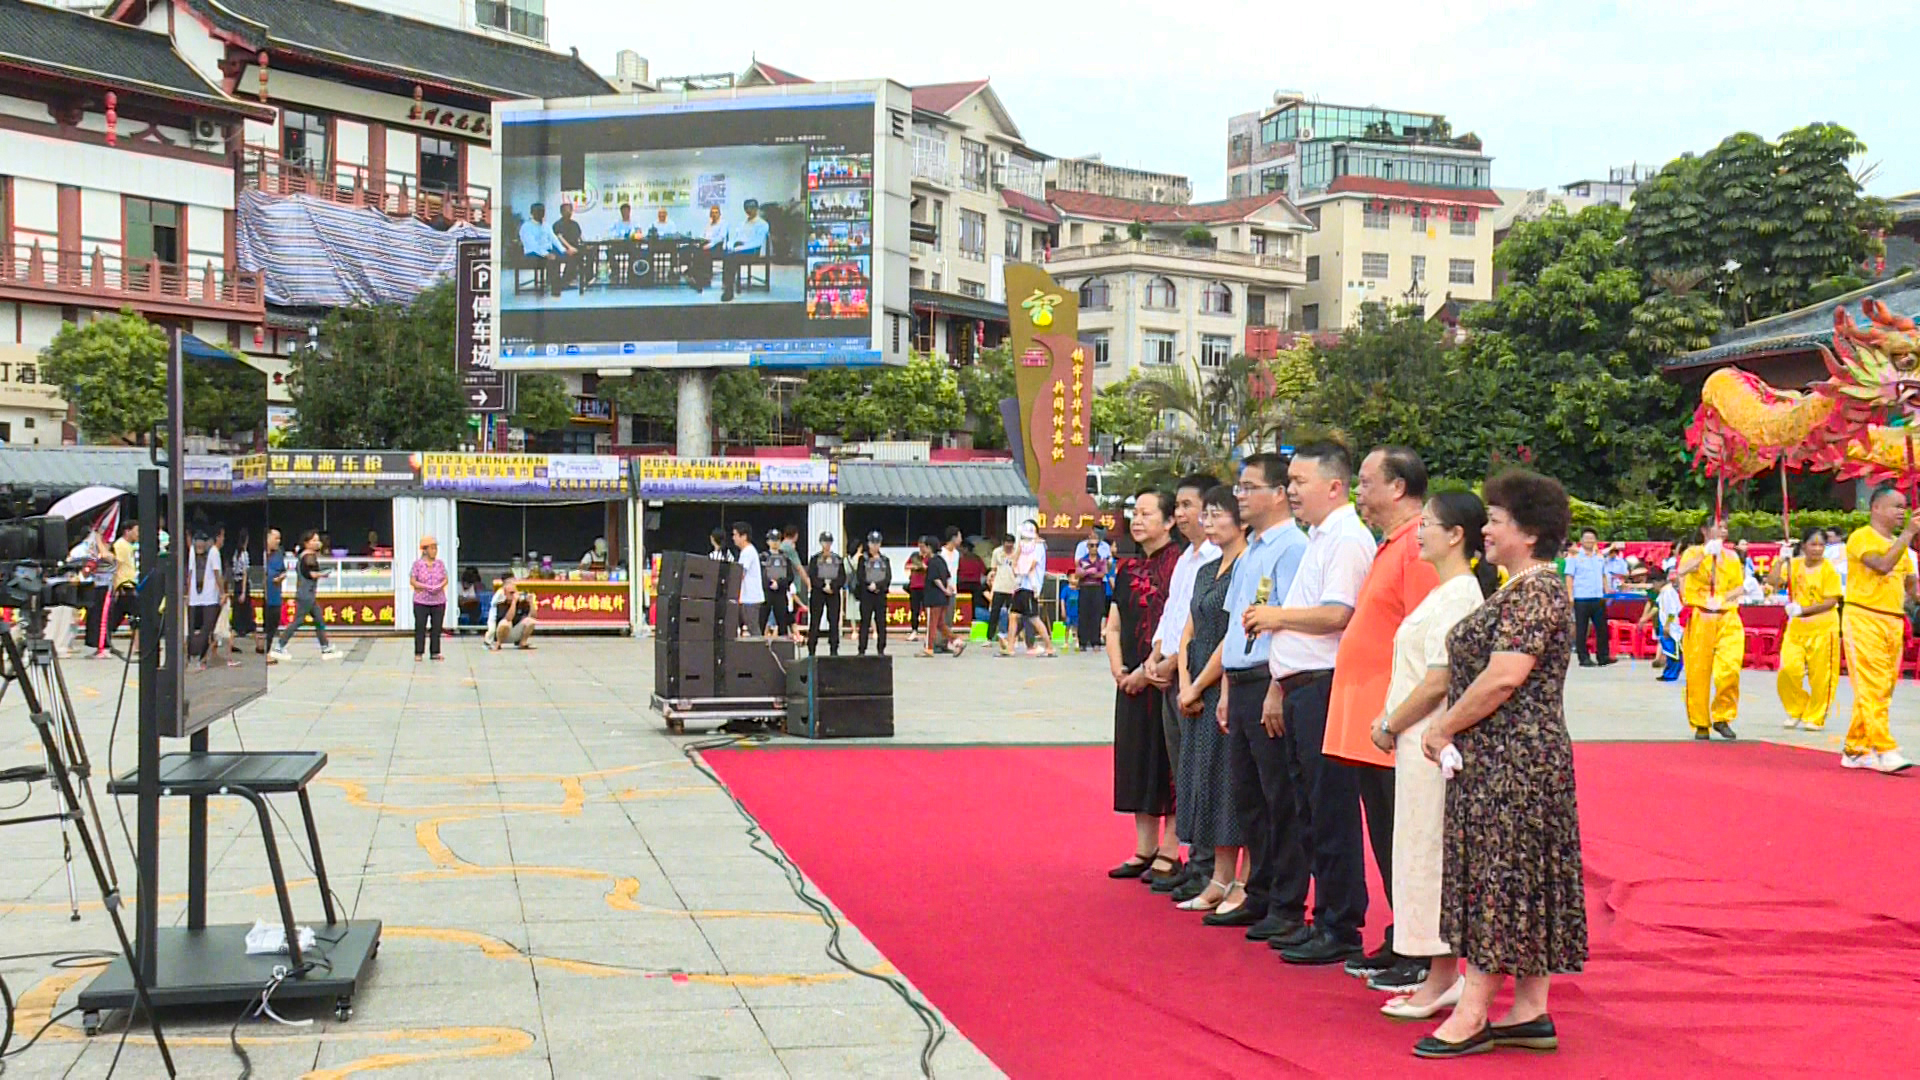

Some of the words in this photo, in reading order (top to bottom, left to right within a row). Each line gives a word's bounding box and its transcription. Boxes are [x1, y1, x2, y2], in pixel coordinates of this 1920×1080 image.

[471, 294, 491, 368] 停车场
[1051, 378, 1066, 463] 共同体意识
[1070, 346, 1085, 446] 铸牢中华民族
